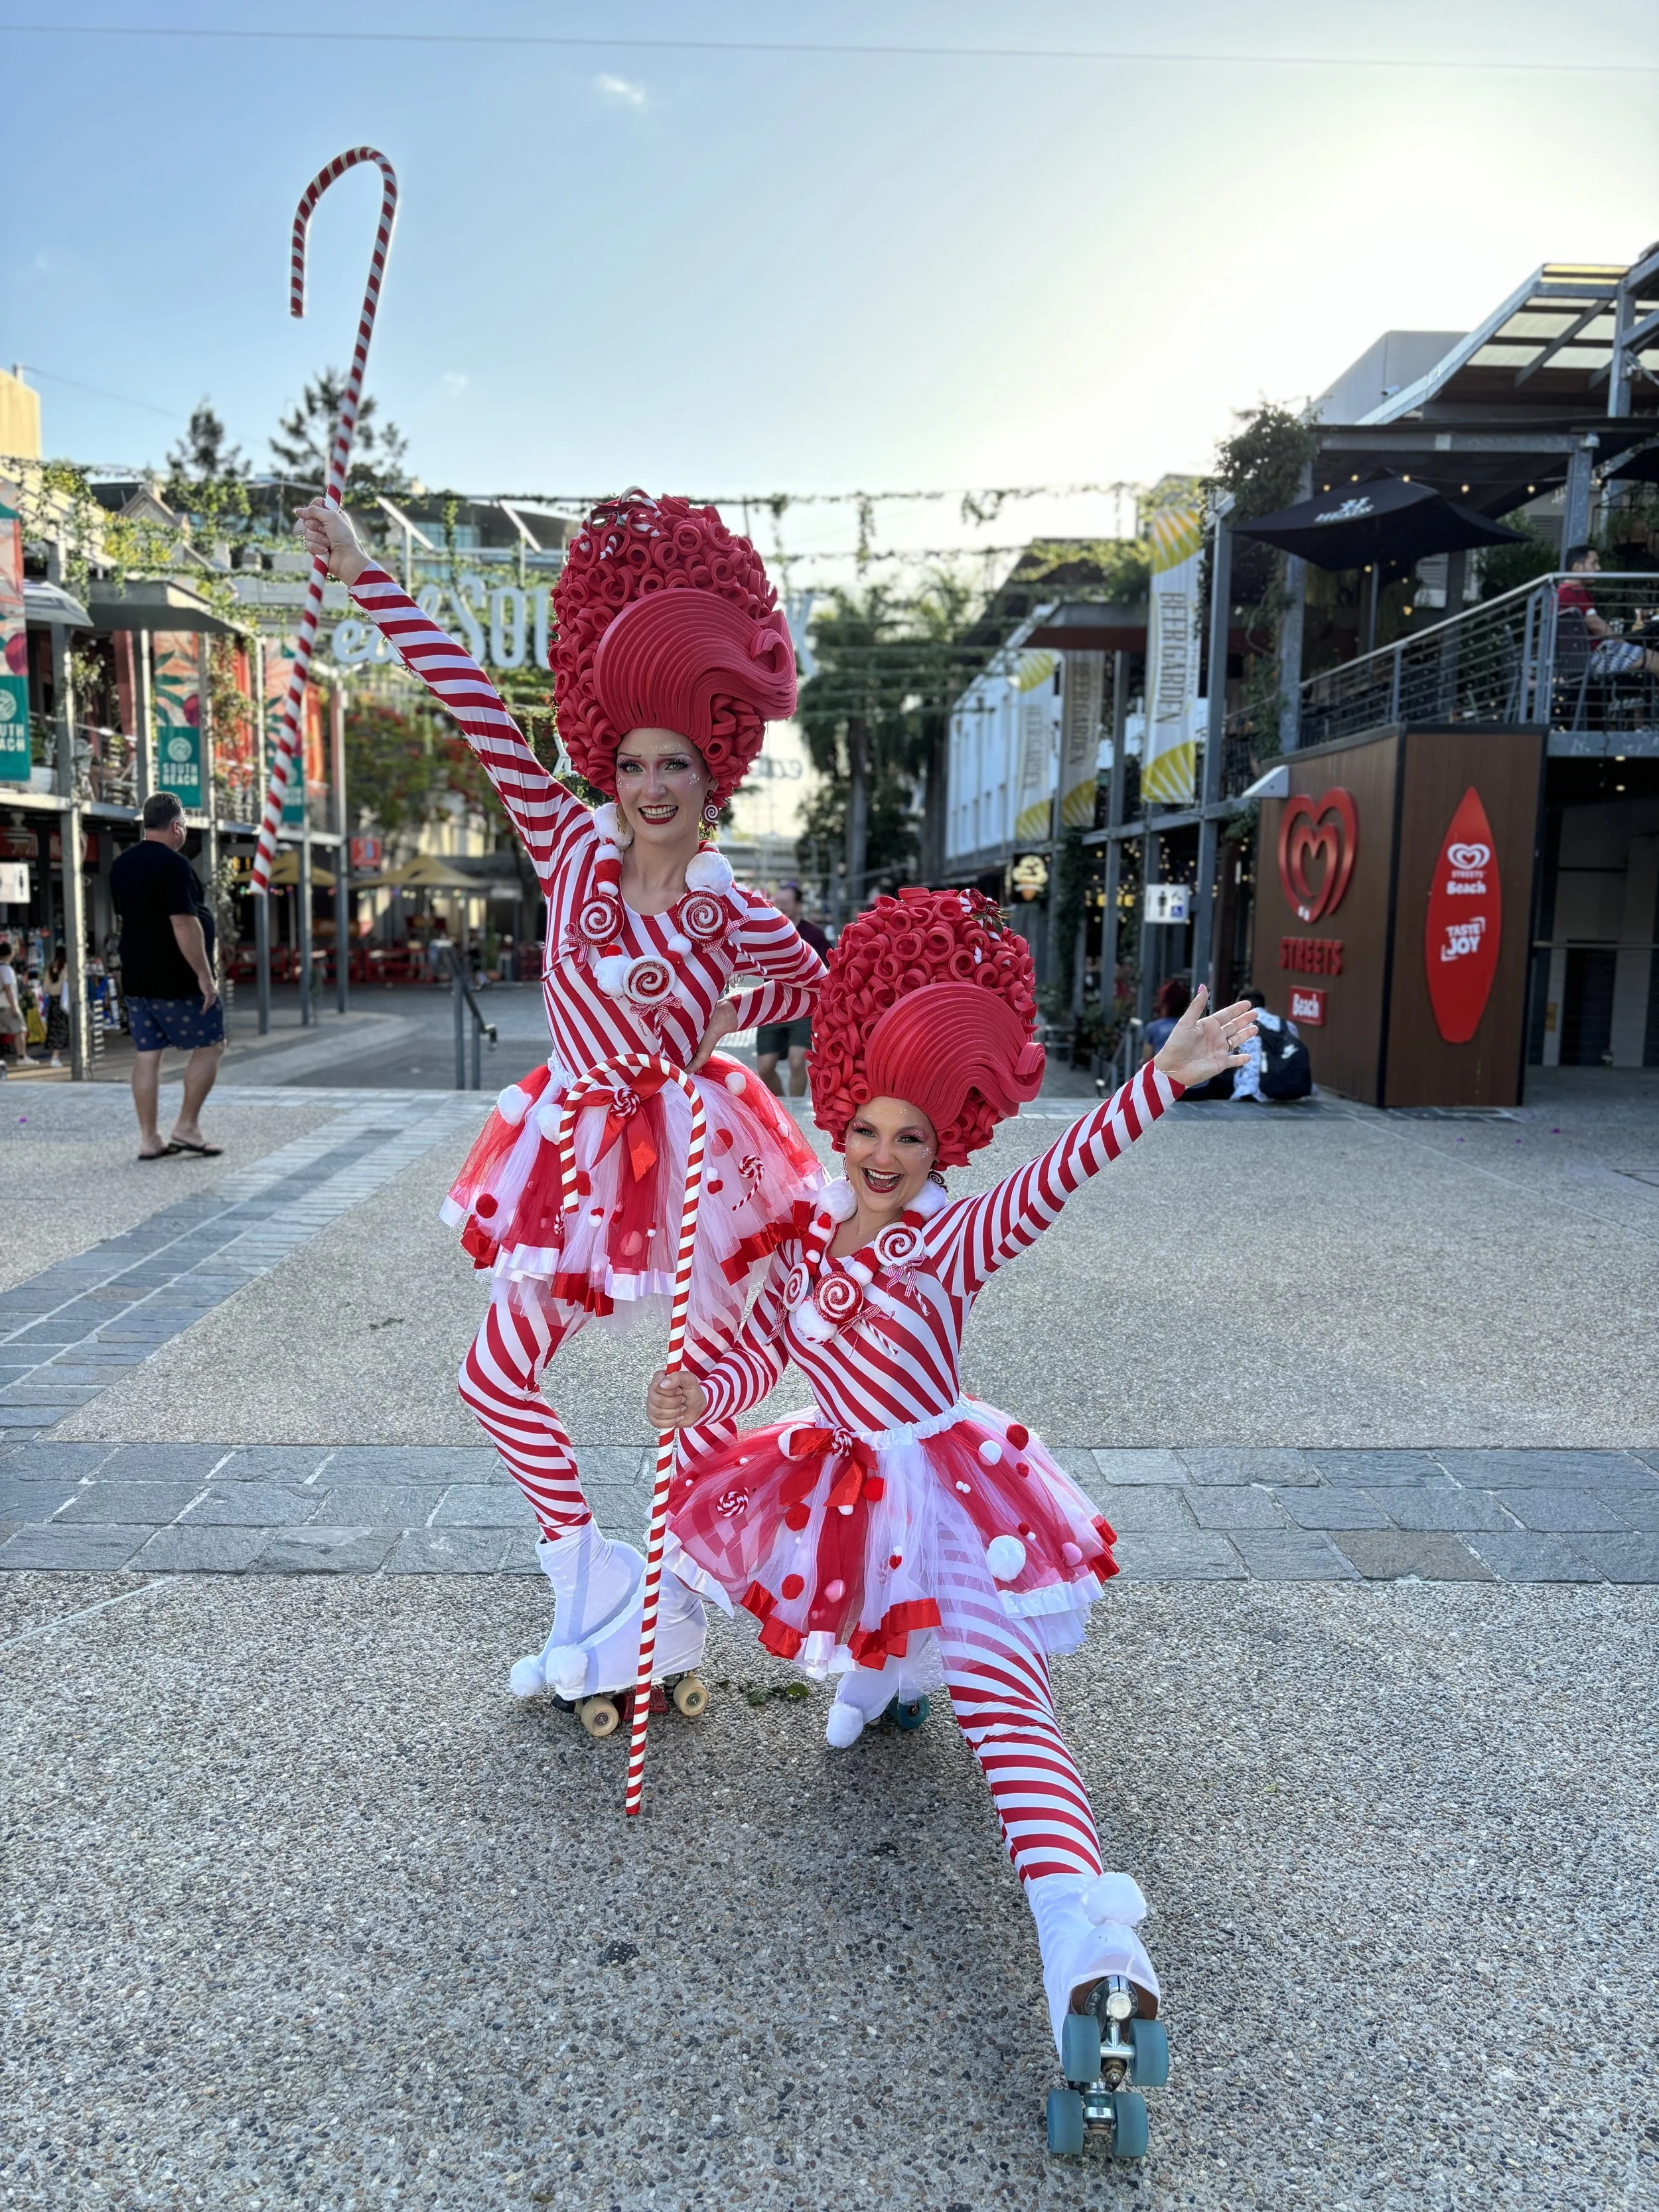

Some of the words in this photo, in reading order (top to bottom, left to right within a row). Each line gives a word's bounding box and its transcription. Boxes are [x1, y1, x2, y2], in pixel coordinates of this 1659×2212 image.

[1158, 591, 1188, 643] BEER
[1155, 644, 1186, 725] GARDEN
[1451, 870, 1484, 879] STREETS
[1446, 880, 1486, 895] Beach
[1445, 923, 1480, 937] TASTE
[1279, 937, 1343, 976] STREETS
[1446, 936, 1480, 956] JOY
[1292, 994, 1320, 1018] Beach
